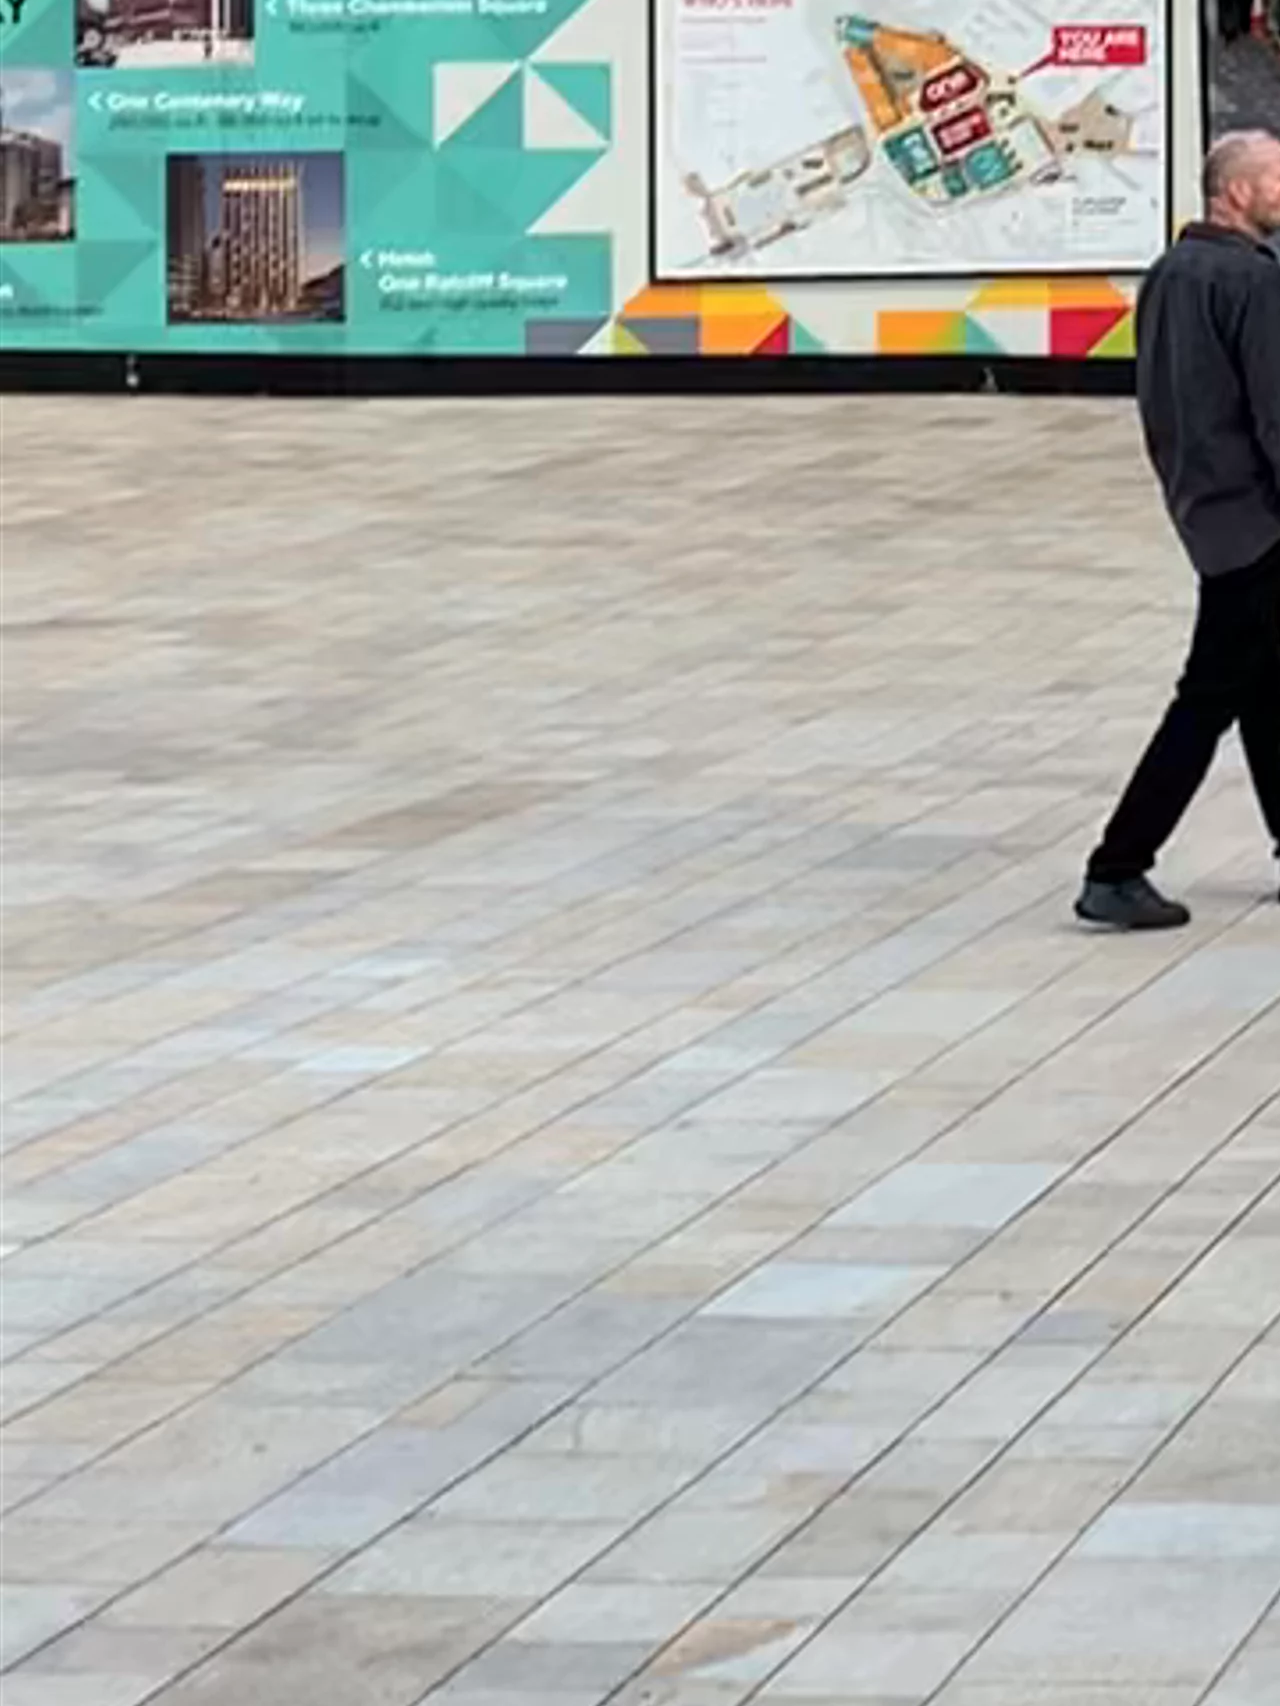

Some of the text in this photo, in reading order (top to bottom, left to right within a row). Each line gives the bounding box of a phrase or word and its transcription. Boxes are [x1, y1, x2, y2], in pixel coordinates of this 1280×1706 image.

[1060, 29, 1138, 46] YOU ARE
[106, 91, 307, 113] One Centenary Way
[378, 273, 420, 293] One
[499, 272, 569, 292] Square
